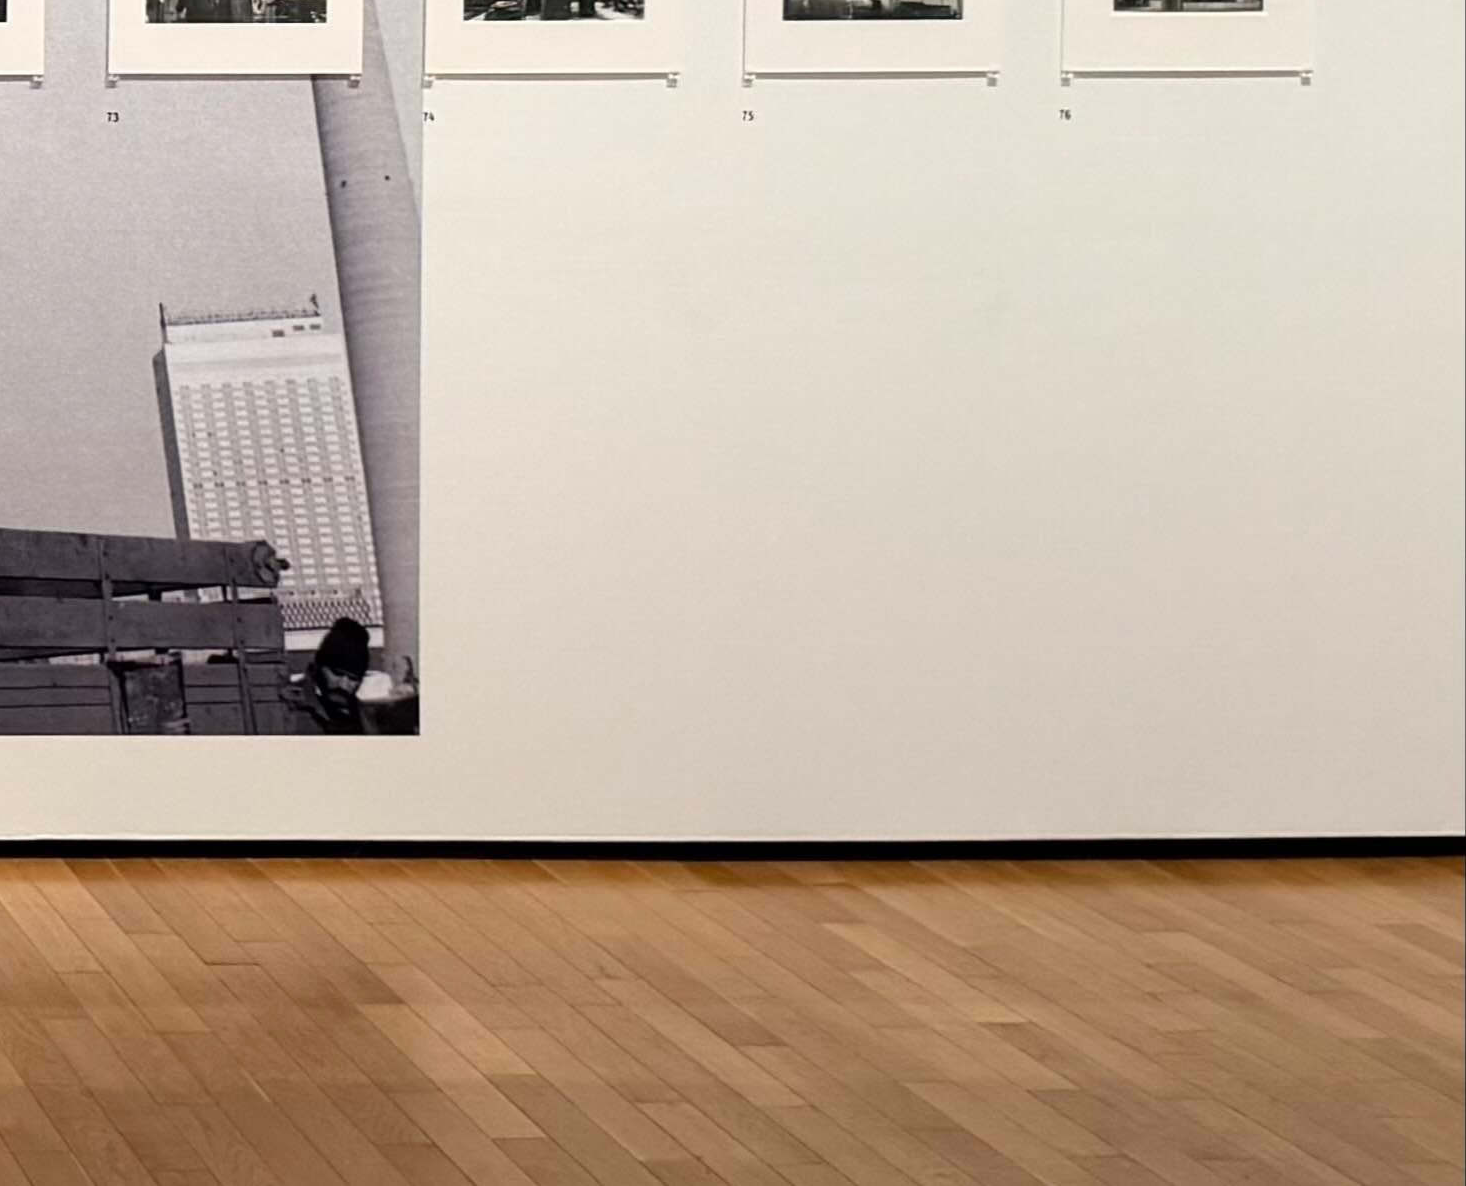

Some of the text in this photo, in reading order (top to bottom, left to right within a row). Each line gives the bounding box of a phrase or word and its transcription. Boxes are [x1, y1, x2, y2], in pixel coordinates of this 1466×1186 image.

[106, 111, 120, 123] 73
[422, 111, 435, 122] 74
[742, 110, 755, 122] 75
[1059, 109, 1072, 121] 76
